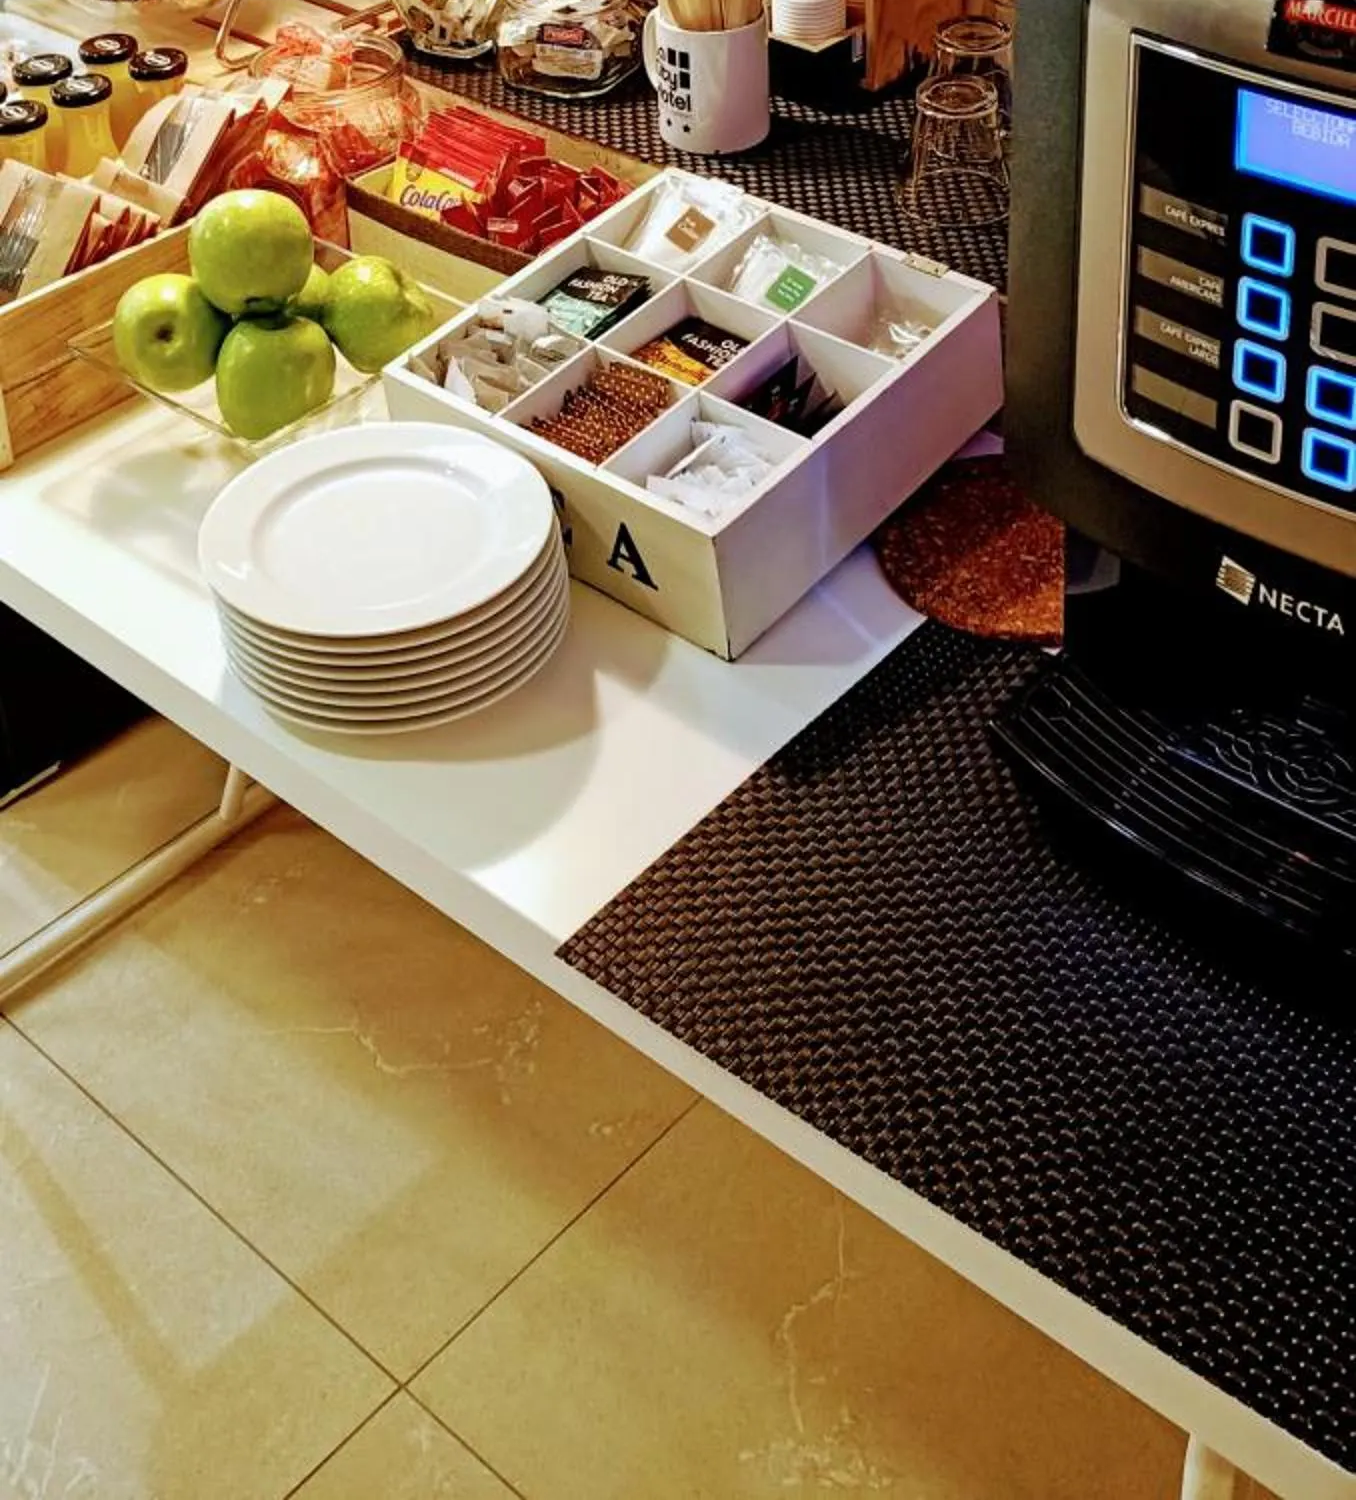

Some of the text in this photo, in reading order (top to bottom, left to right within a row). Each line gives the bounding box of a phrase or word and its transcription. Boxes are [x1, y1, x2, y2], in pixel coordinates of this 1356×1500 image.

[658, 84, 692, 112] otel
[567, 278, 620, 294] FASHION
[603, 275, 629, 287] OLD
[721, 339, 741, 353] OL
[1258, 582, 1345, 636] NECTA
